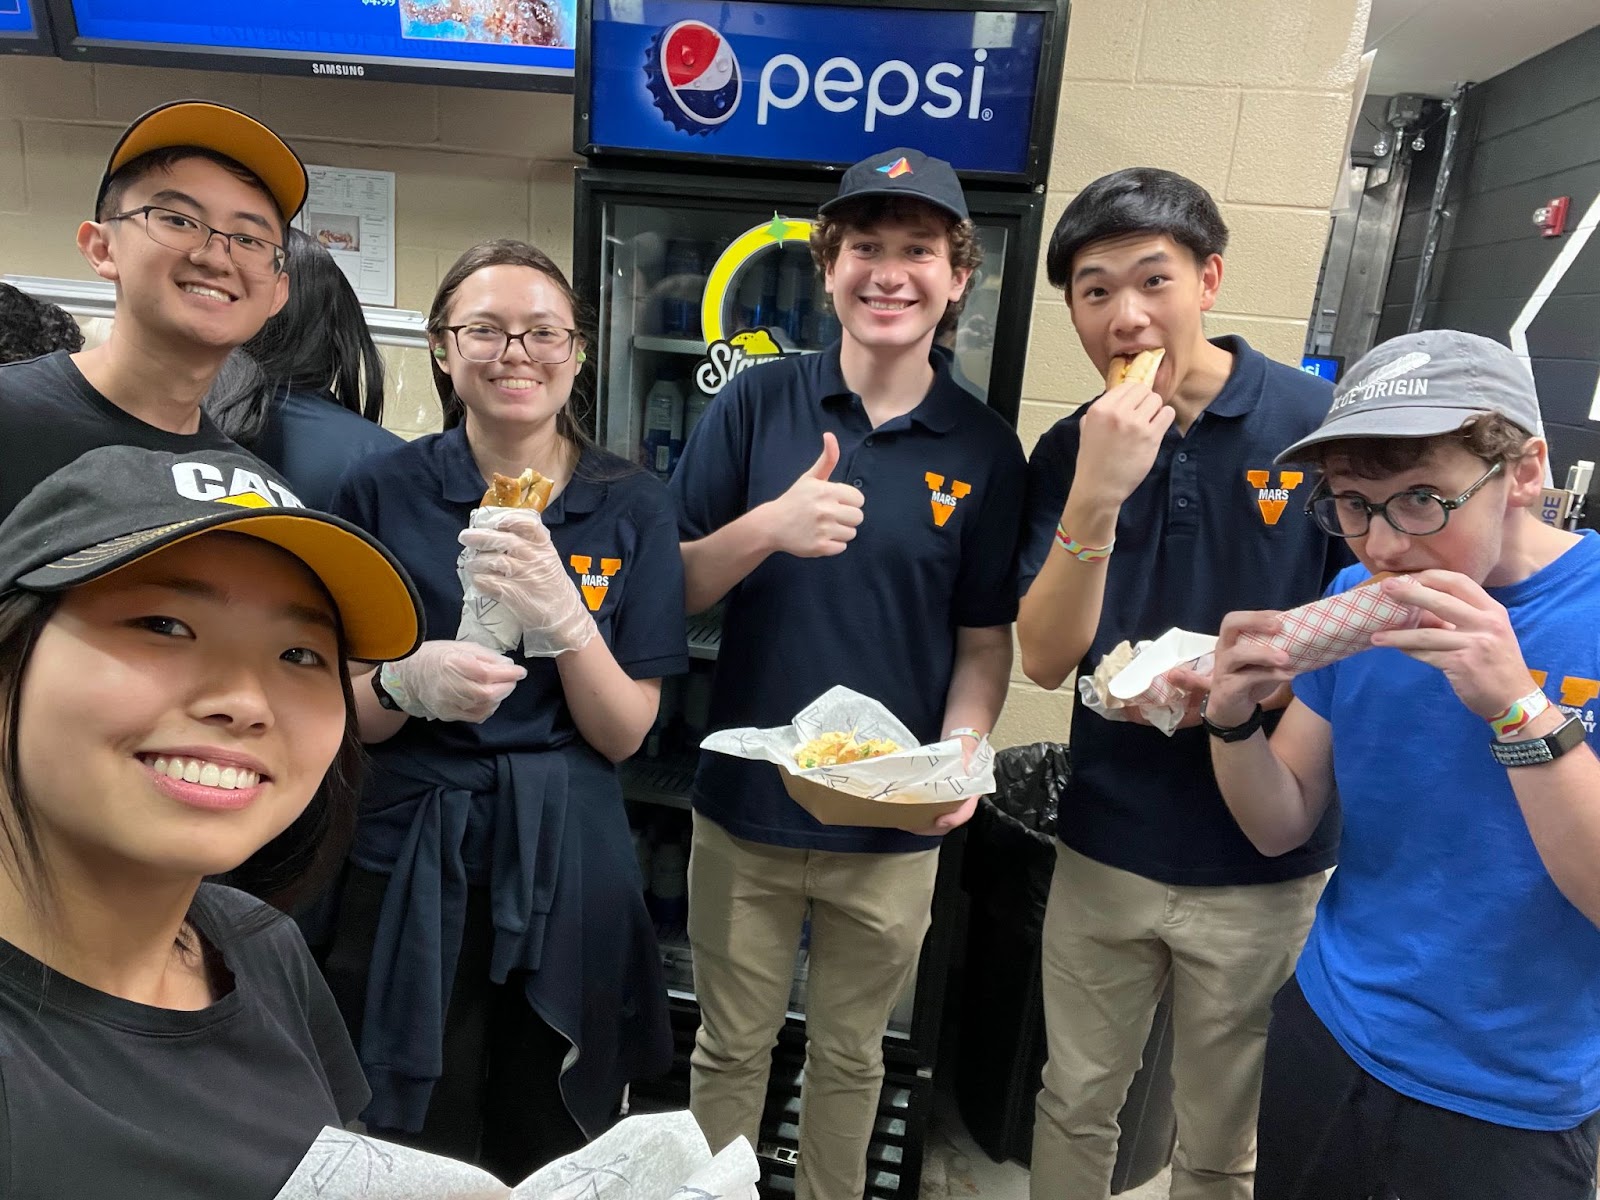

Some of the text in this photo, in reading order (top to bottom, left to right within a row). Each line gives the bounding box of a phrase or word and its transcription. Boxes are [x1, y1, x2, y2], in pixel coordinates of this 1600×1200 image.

[312, 63, 365, 76] SAMSUNG
[757, 48, 988, 132] pepsi
[1363, 378, 1429, 401] ORIGIN
[172, 462, 306, 508] CAT
[931, 490, 957, 507] MARS
[1258, 488, 1290, 500] MARS
[581, 574, 609, 587] MARS
